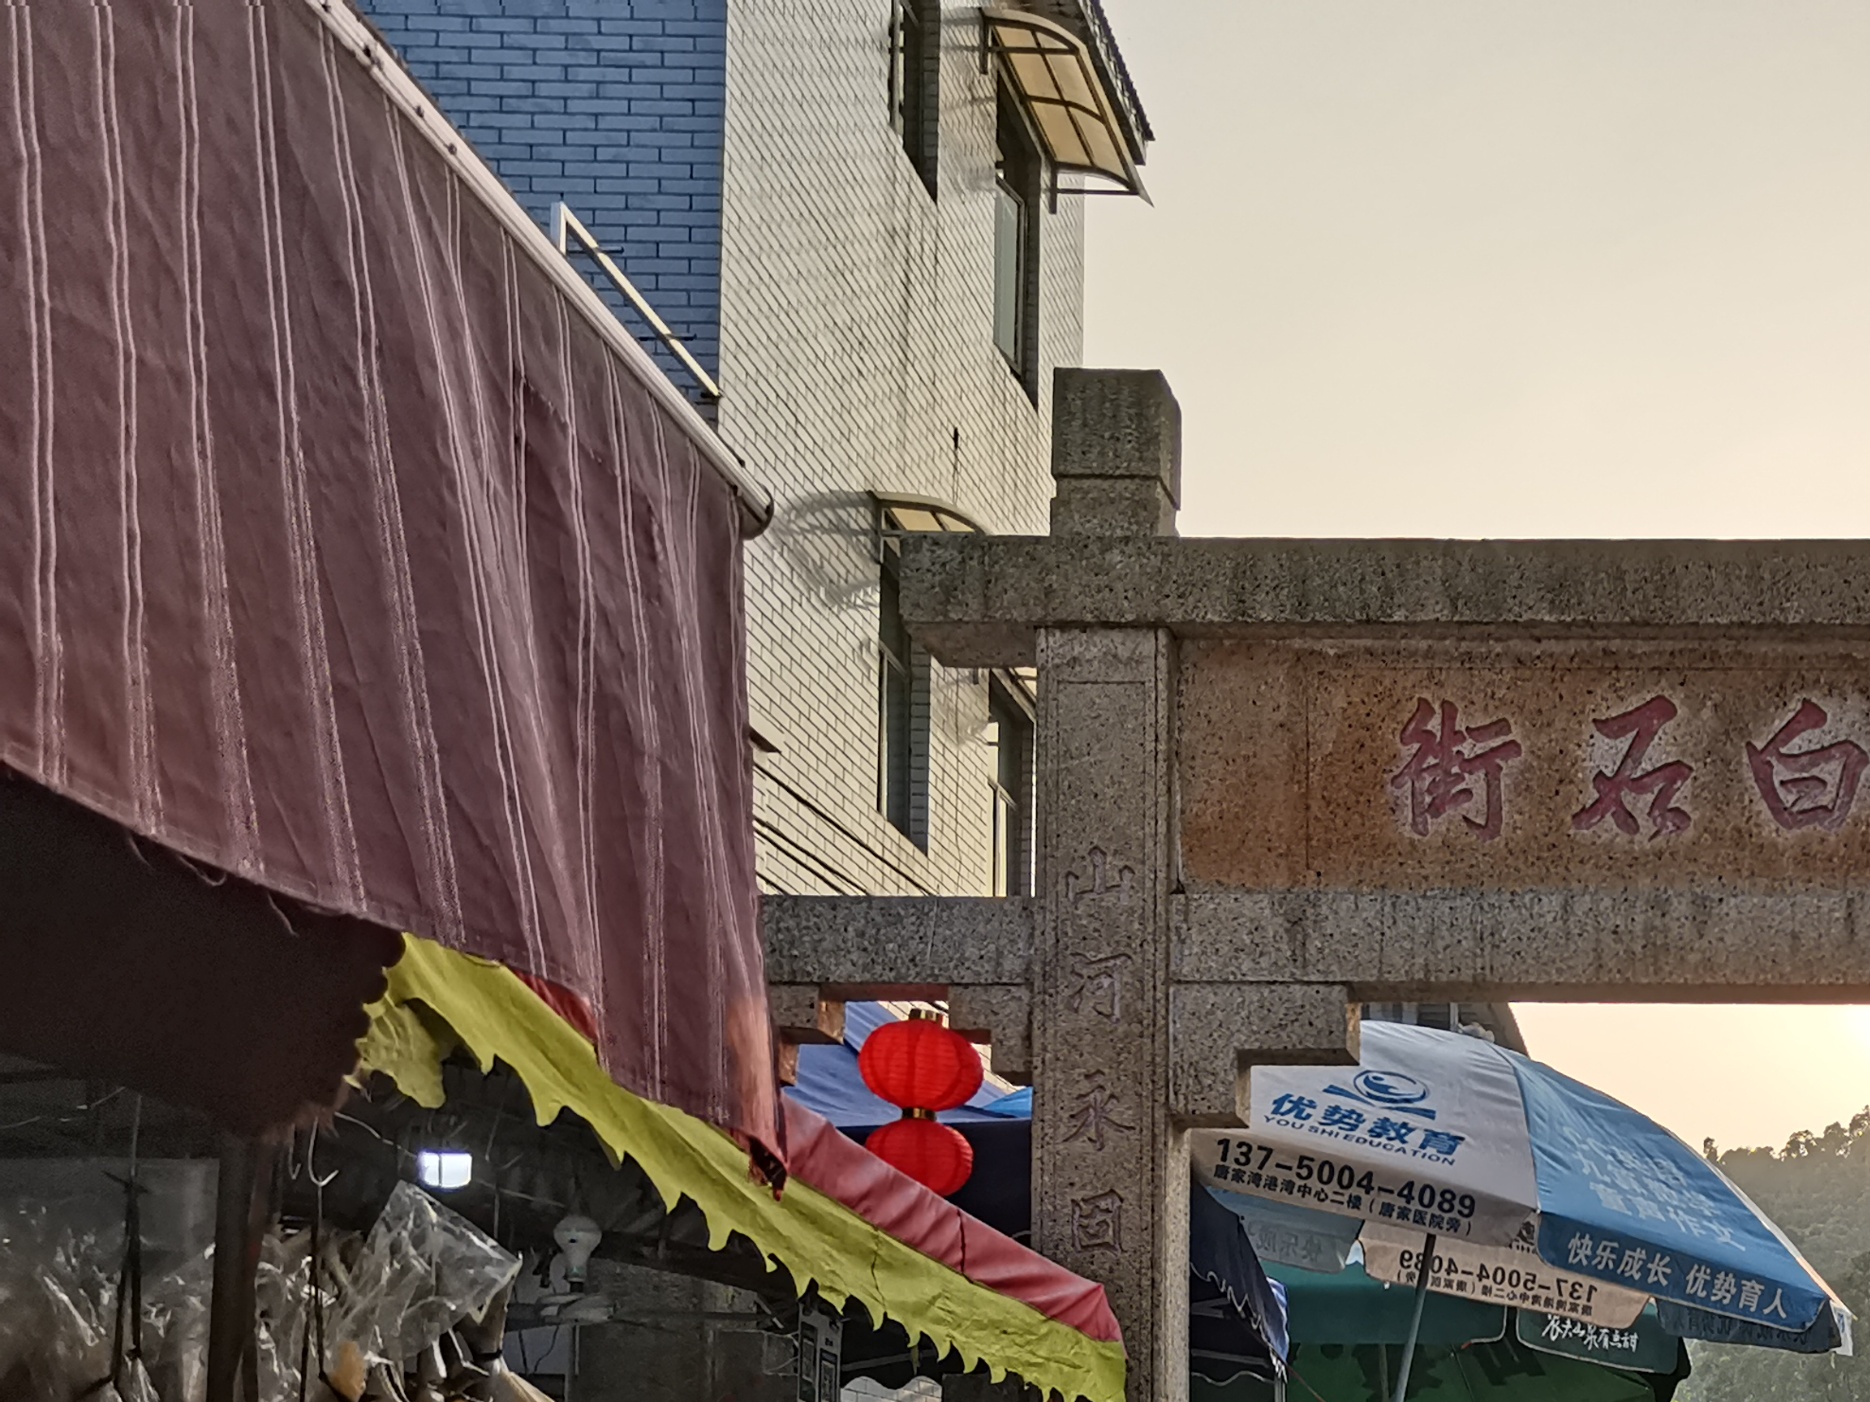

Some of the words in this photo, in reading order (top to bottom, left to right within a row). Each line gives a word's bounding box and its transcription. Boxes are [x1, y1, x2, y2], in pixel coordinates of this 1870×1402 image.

[1390, 695, 1870, 842] 白石街
[1264, 1115, 1302, 1130] YOU
[1308, 1126, 1340, 1139] SHI
[1343, 1133, 1456, 1166] EDUCATION
[1272, 1092, 1465, 1156] 优势教育
[1217, 1138, 1476, 1218] 137-5004-4089
[1568, 1232, 1672, 1286] 快乐成长
[1685, 1264, 1787, 1318] 优势育人
